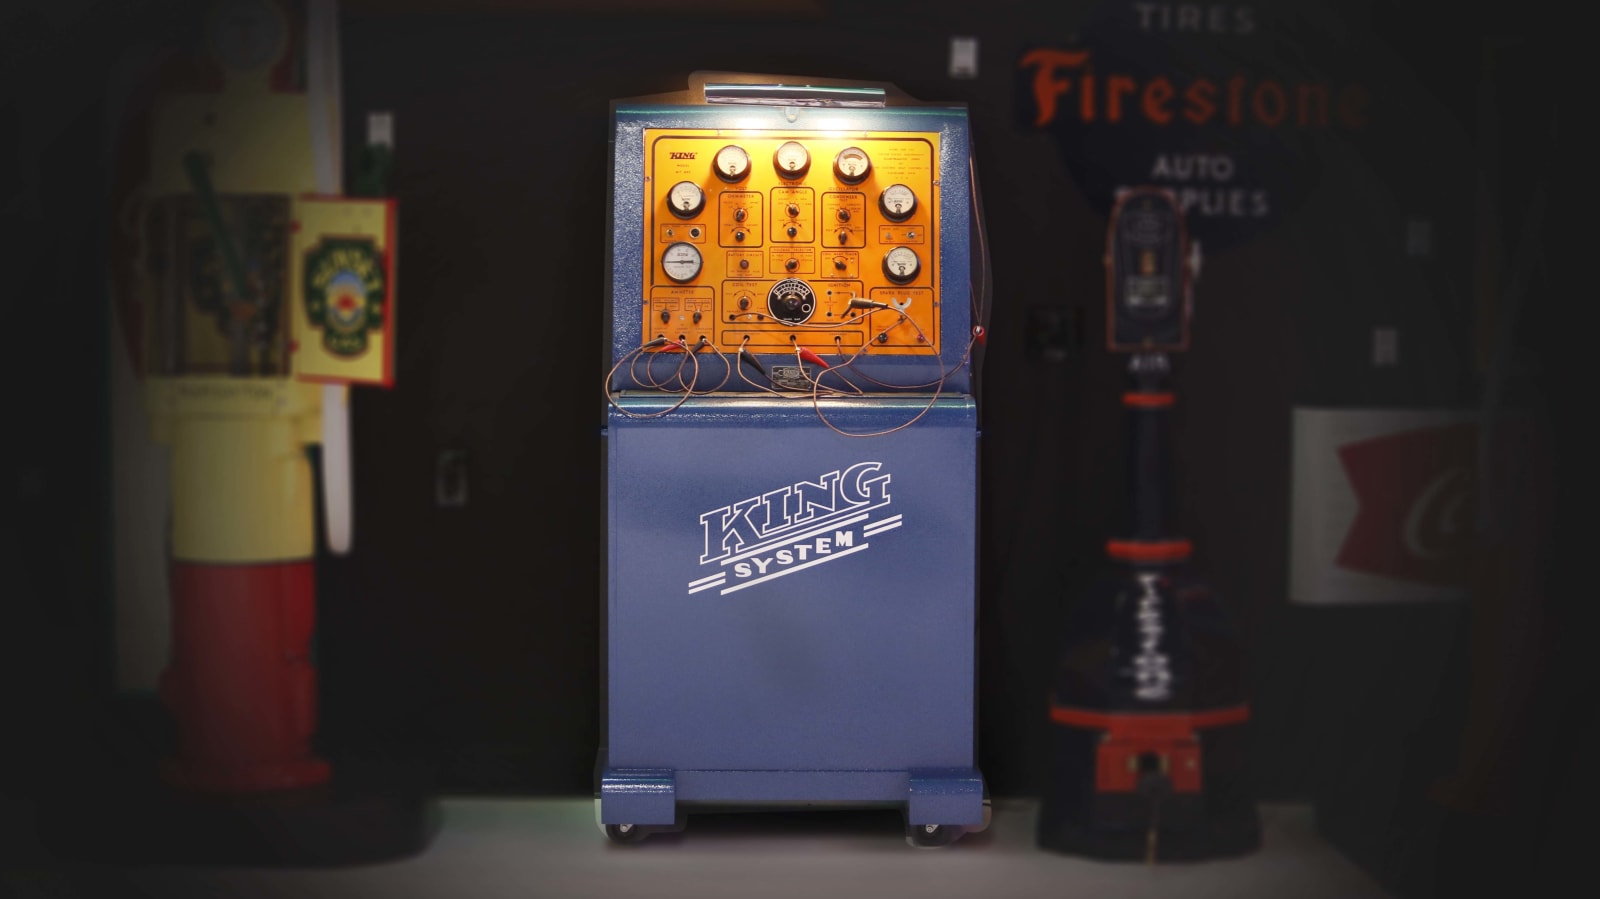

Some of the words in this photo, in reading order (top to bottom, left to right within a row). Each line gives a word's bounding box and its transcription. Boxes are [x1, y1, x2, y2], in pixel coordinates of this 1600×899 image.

[1135, 3, 1256, 33] TIRES
[1019, 48, 1370, 127] Firestone
[1151, 155, 1235, 181] AUTO
[1115, 187, 1270, 217] PLIES
[699, 461, 891, 565] KING
[734, 530, 854, 578] SYSTEM
